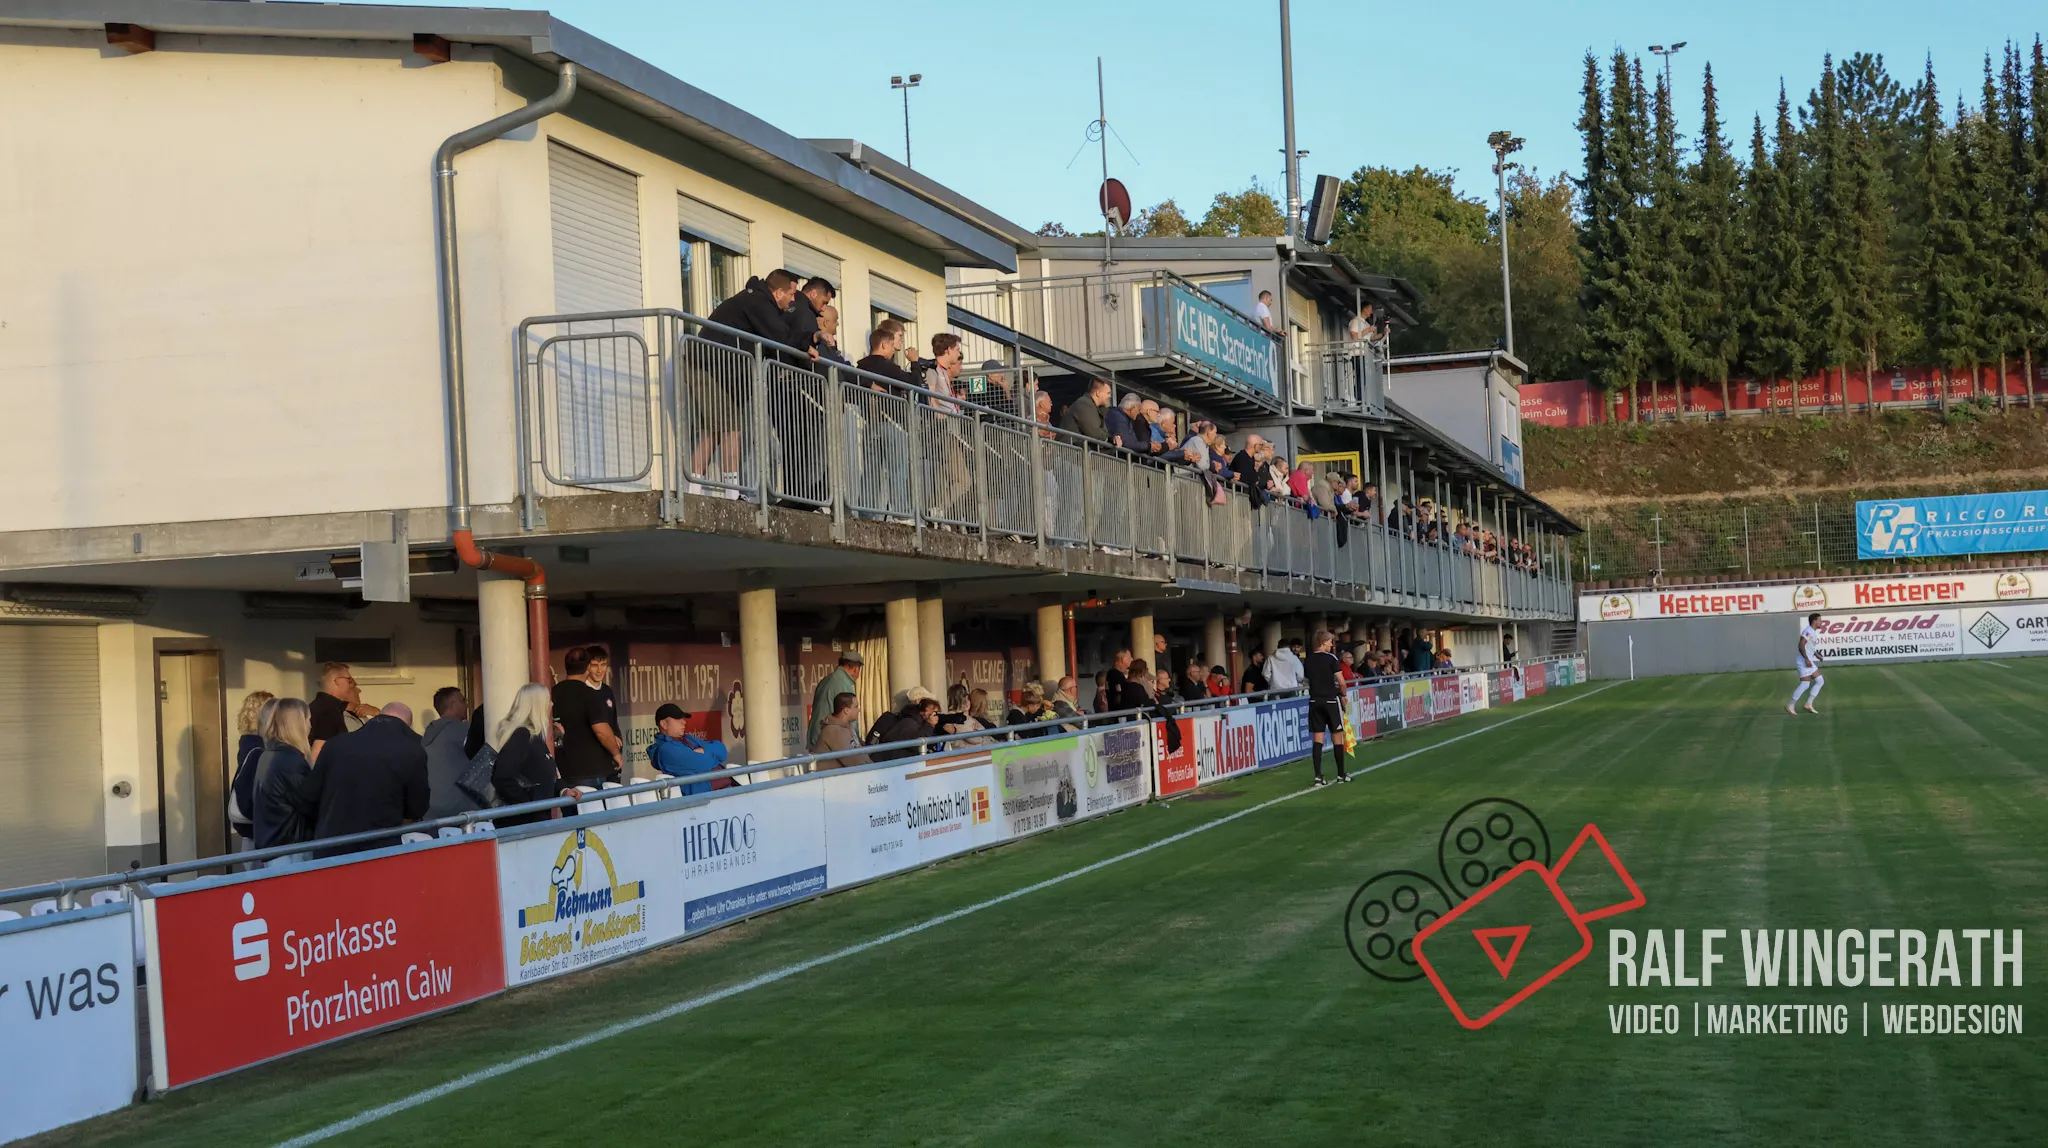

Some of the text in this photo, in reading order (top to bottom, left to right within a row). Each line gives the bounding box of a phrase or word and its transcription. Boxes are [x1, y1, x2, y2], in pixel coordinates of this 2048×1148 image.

[1544, 406, 1568, 417] Calw
[1766, 394, 1819, 407] Porzeim
[1926, 504, 2048, 523] RICCO R
[1926, 525, 2048, 538] PRÄZISIONSSCHLEIF
[1659, 593, 1764, 614] Ketterer
[1854, 582, 1965, 604] Ketterer
[1815, 634, 1886, 645] ONNENSCHUTZ
[1898, 631, 1955, 641] METALLBAU
[1865, 644, 1918, 656] MARKISEN
[620, 658, 689, 703] NÖTTINGEN
[694, 664, 720, 700] 1957
[1256, 704, 1301, 762] KRÖNER
[906, 789, 970, 829] Schwäbisch Hall
[683, 812, 757, 864] HERZOG
[684, 851, 757, 880] UHRARMBÄNDER
[283, 917, 397, 977] Sparkasse
[520, 923, 573, 967] Bäckerei
[562, 956, 569, 969] 62
[25, 962, 120, 1020] was
[286, 959, 453, 1036] Pforzheim Calw
